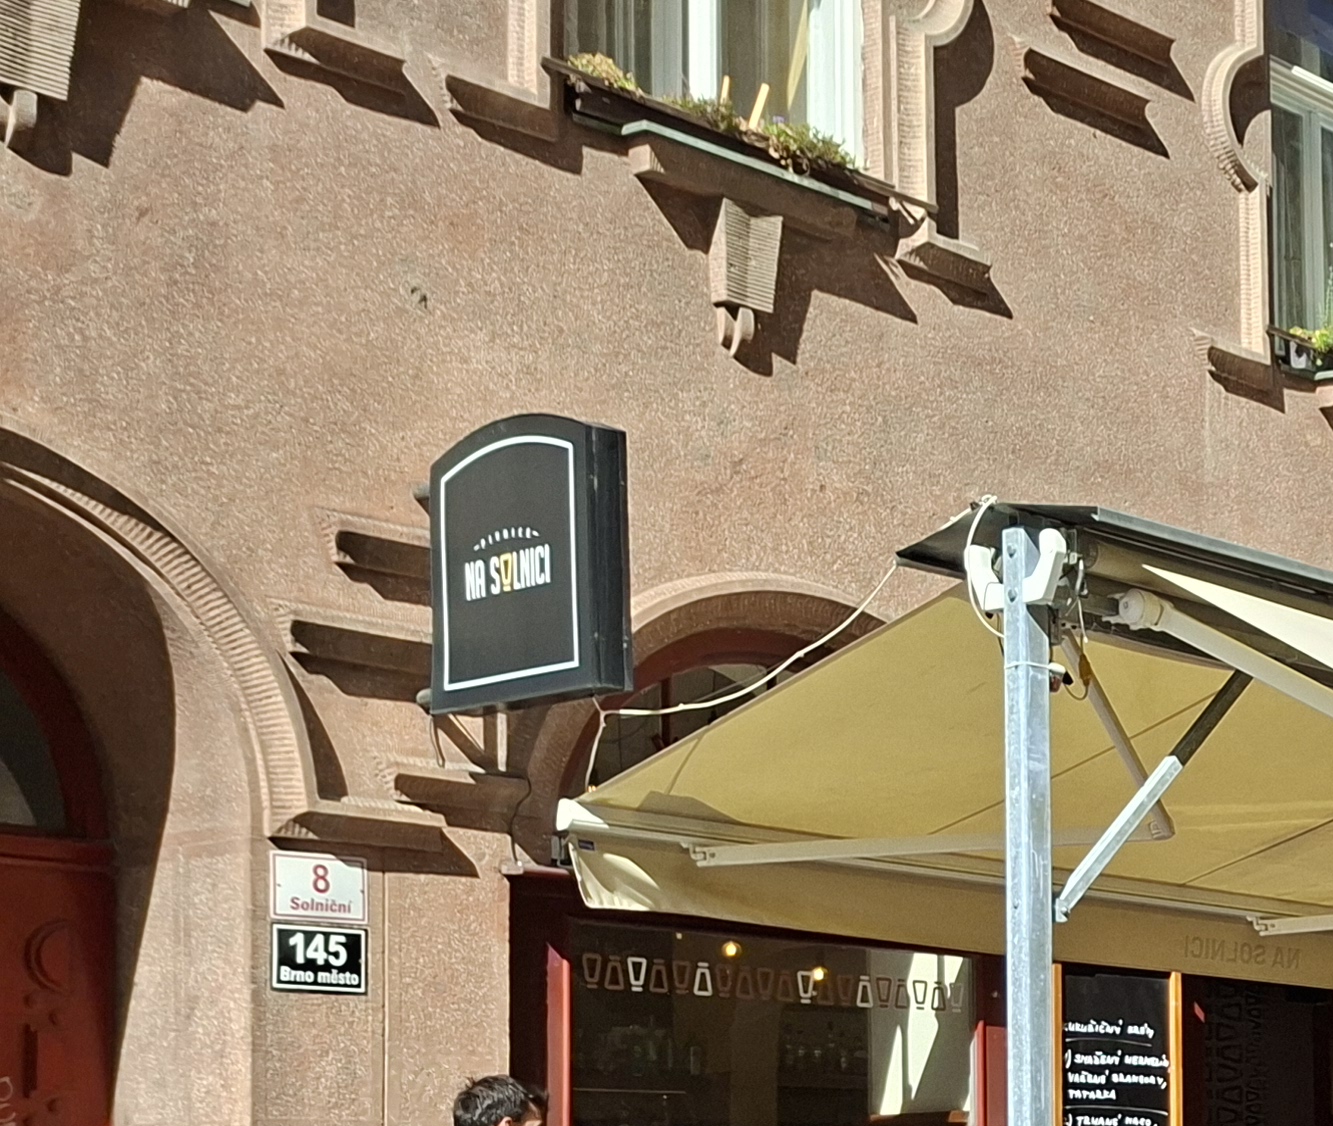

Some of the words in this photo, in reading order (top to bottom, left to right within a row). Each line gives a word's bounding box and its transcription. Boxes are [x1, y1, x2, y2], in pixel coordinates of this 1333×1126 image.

[465, 559, 487, 601] NA
[490, 544, 551, 596] SOLNICI
[312, 864, 330, 894] 8
[290, 896, 352, 914] Solniční
[288, 932, 348, 967] 145
[279, 965, 315, 983] Brno
[317, 968, 360, 986] město
